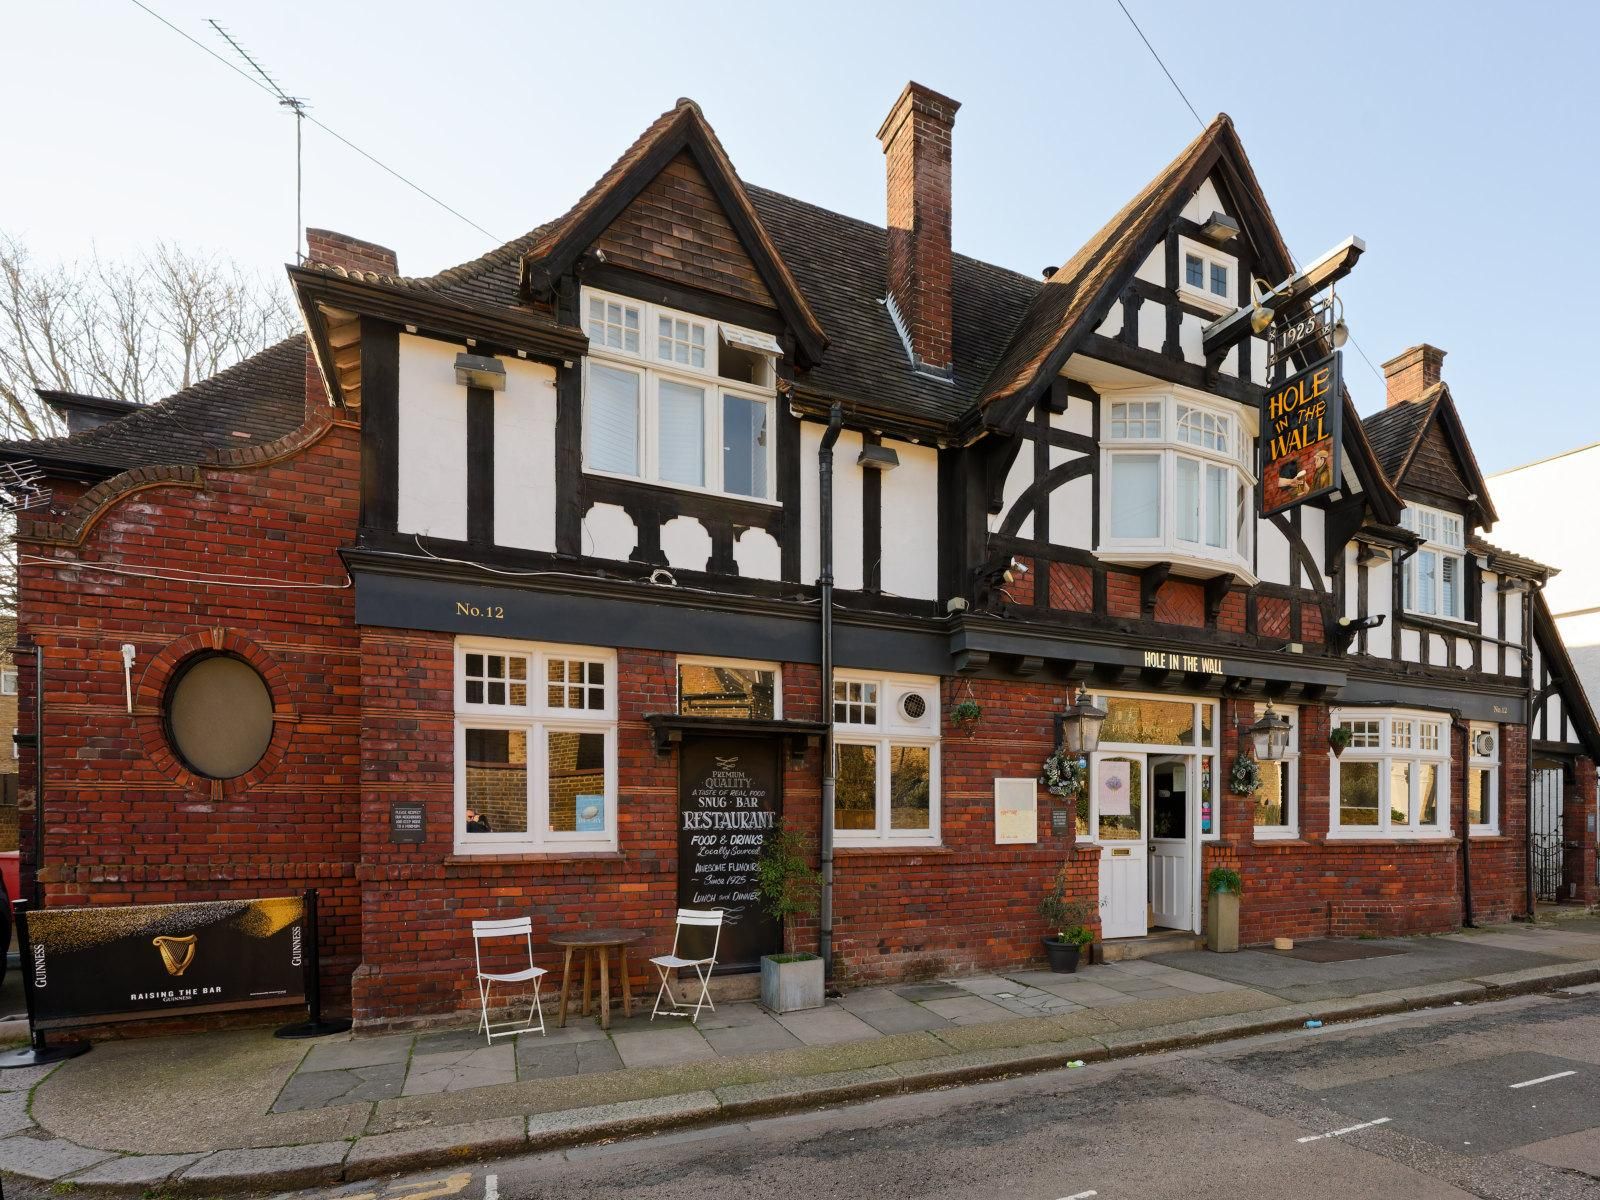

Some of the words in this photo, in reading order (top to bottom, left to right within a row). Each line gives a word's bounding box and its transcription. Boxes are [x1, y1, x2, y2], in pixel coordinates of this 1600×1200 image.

[1282, 316, 1316, 348] 1925
[1269, 367, 1330, 420] HOLE
[1275, 416, 1289, 433] IN
[1298, 401, 1326, 424] THE
[1270, 417, 1329, 461] WALL
[456, 601, 504, 619] No.12
[1144, 651, 1166, 669] HOLE
[1169, 654, 1179, 670] IN
[1183, 655, 1198, 672] THE
[1201, 657, 1223, 674] WALL
[712, 770, 745, 778] PREMIUM
[705, 777, 752, 789] QUALITY
[730, 789, 747, 797] REAL
[698, 796, 727, 808] SNUG
[736, 797, 759, 808] BAR
[682, 811, 776, 830] RESTAURANT
[690, 835, 717, 845] FOOD
[719, 834, 727, 845] &
[730, 834, 763, 845] DRINKS
[697, 846, 730, 859] Locally
[730, 845, 761, 856] Sourced
[695, 862, 726, 873] AWESOME
[704, 874, 725, 885] Since
[726, 875, 747, 885] 1925
[693, 891, 716, 903] LUNCH
[292, 926, 302, 966] GUINNESS
[35, 944, 47, 988] GUINNESS
[130, 990, 174, 1001] RAISING
[179, 988, 198, 996] THE
[202, 986, 221, 994] BAR
[162, 995, 192, 1003] GUINNESS
